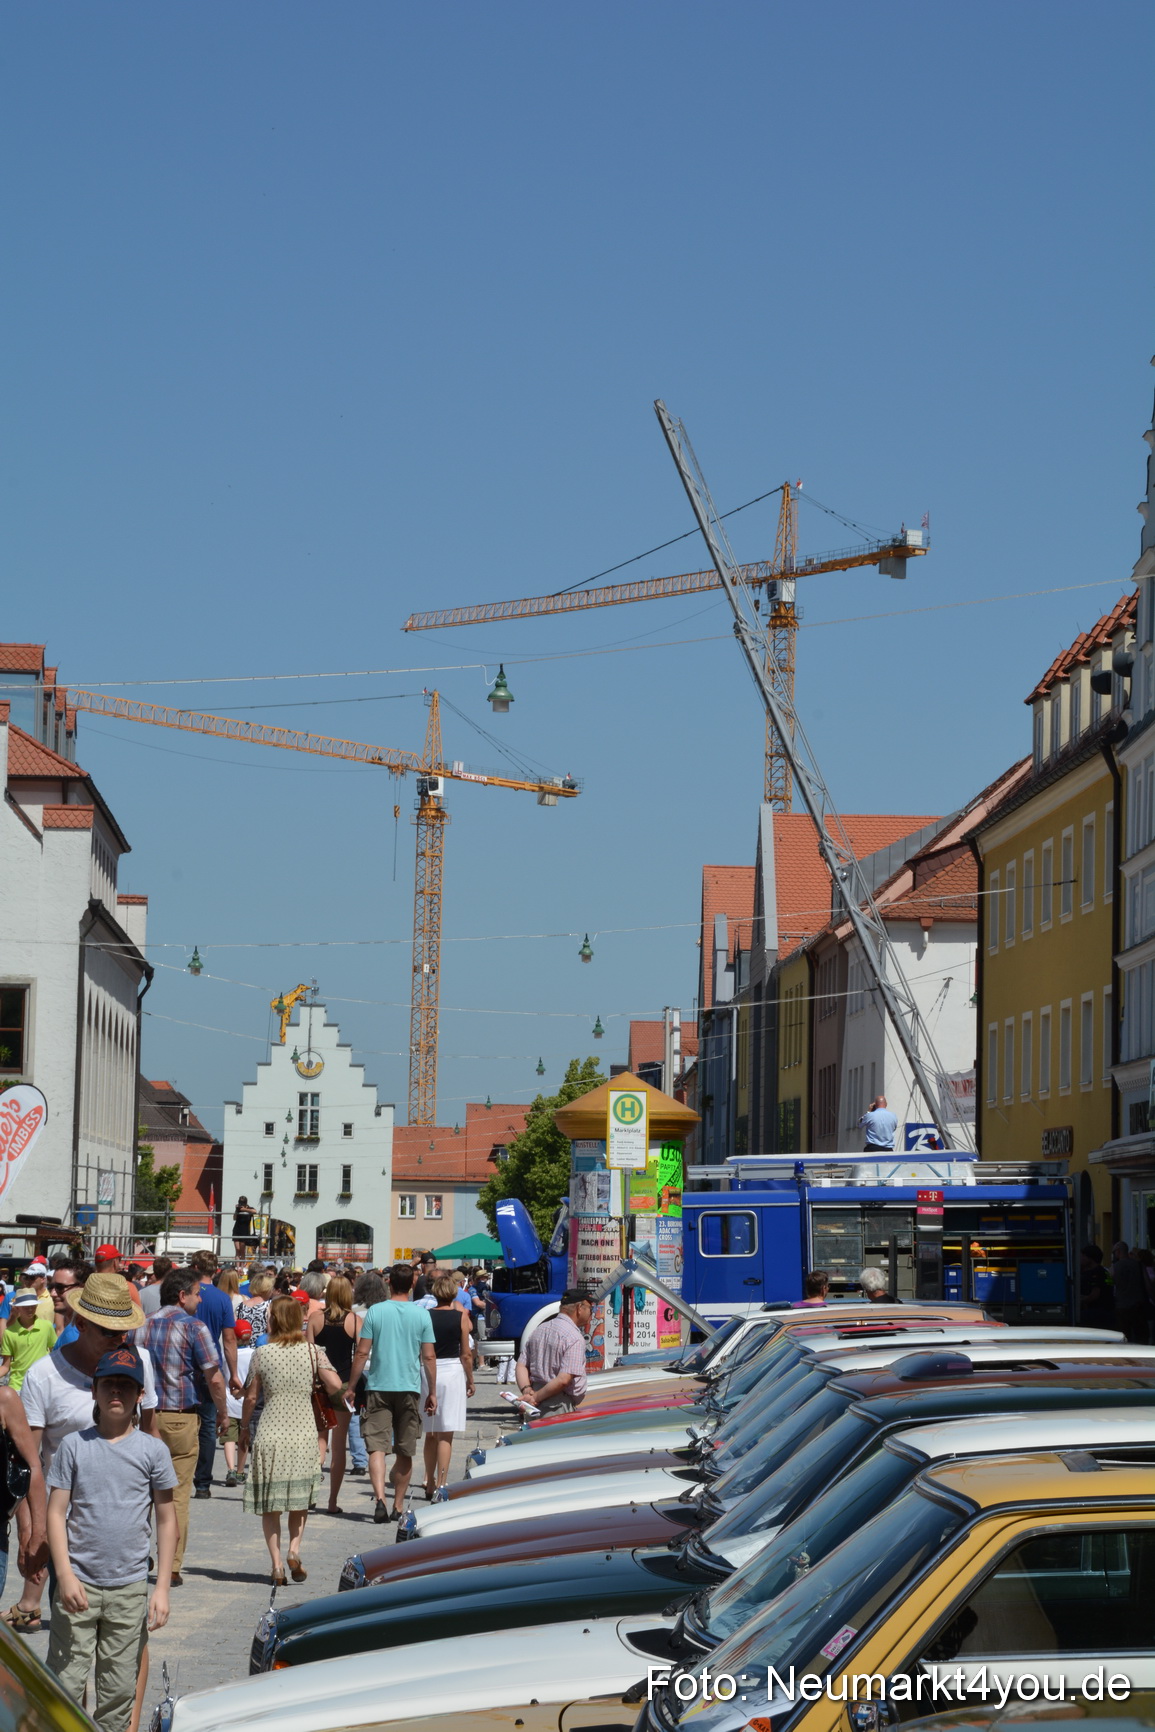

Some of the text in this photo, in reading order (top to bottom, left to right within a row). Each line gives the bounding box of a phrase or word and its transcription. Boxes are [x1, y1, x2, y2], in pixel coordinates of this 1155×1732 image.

[620, 1101, 635, 1118] H
[8, 1110, 41, 1158] IMBISS
[600, 1239, 615, 1247] ONE
[637, 1330, 656, 1339] 2014
